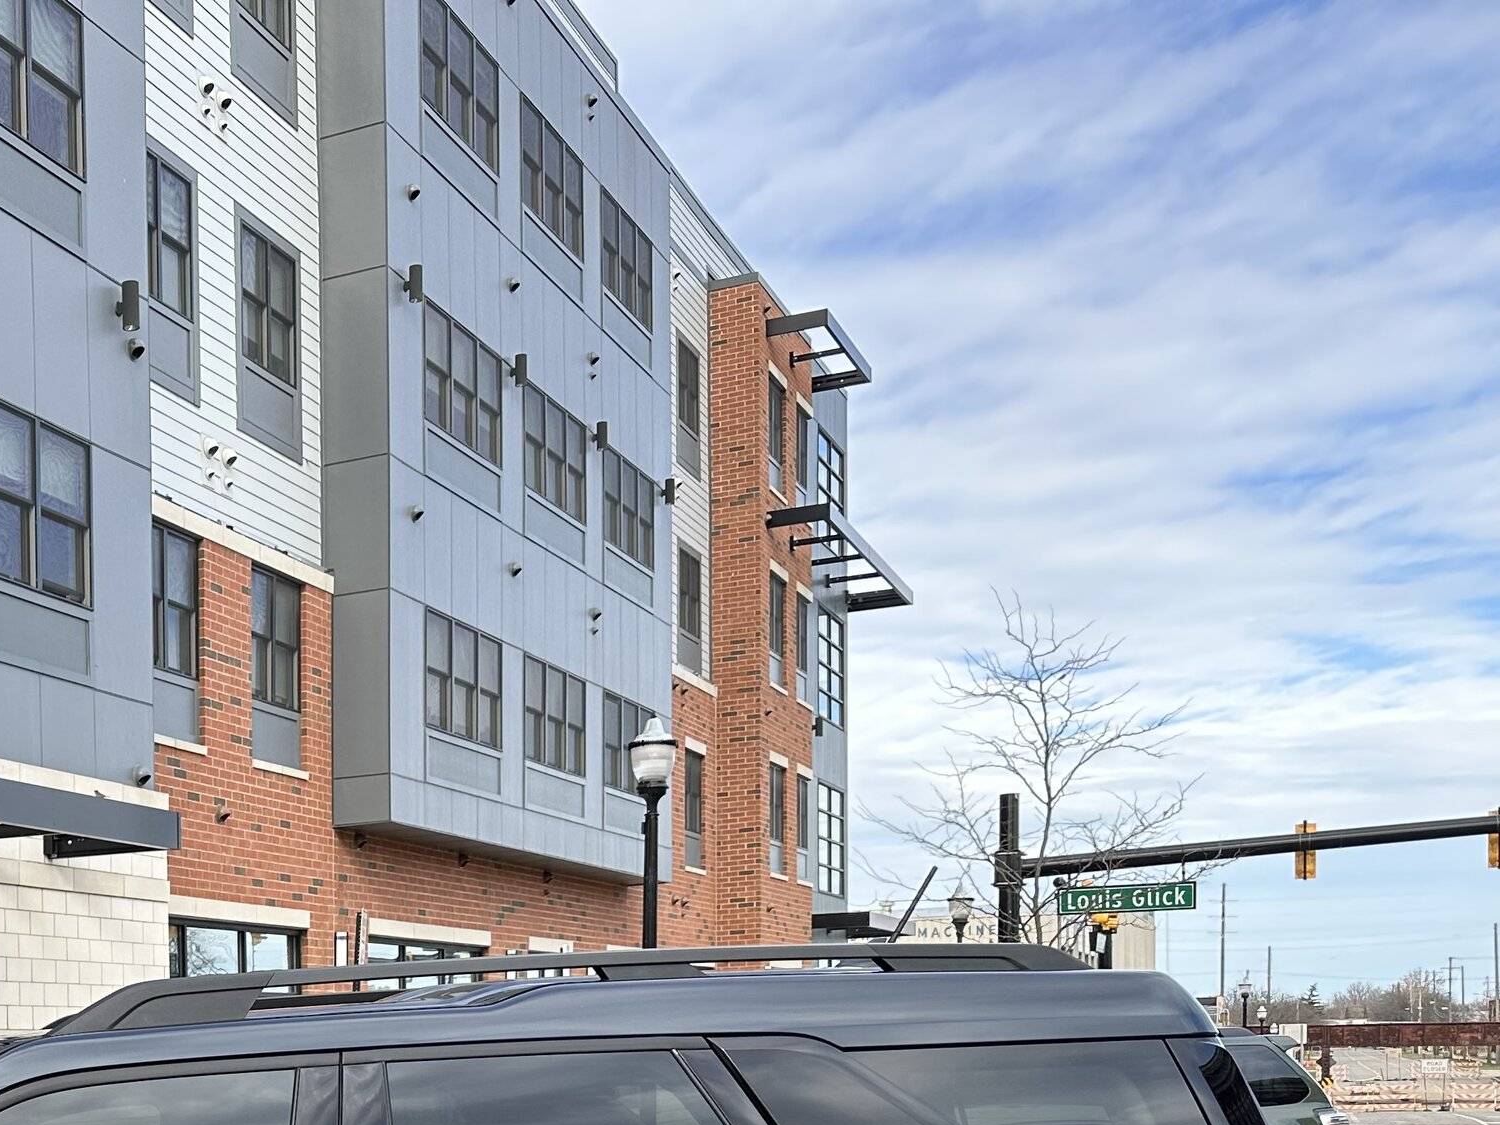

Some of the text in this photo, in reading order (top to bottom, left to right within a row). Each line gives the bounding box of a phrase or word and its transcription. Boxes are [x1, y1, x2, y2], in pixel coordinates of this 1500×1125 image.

[1067, 886, 1186, 910] Louis Glick
[918, 924, 997, 938] MACINE
